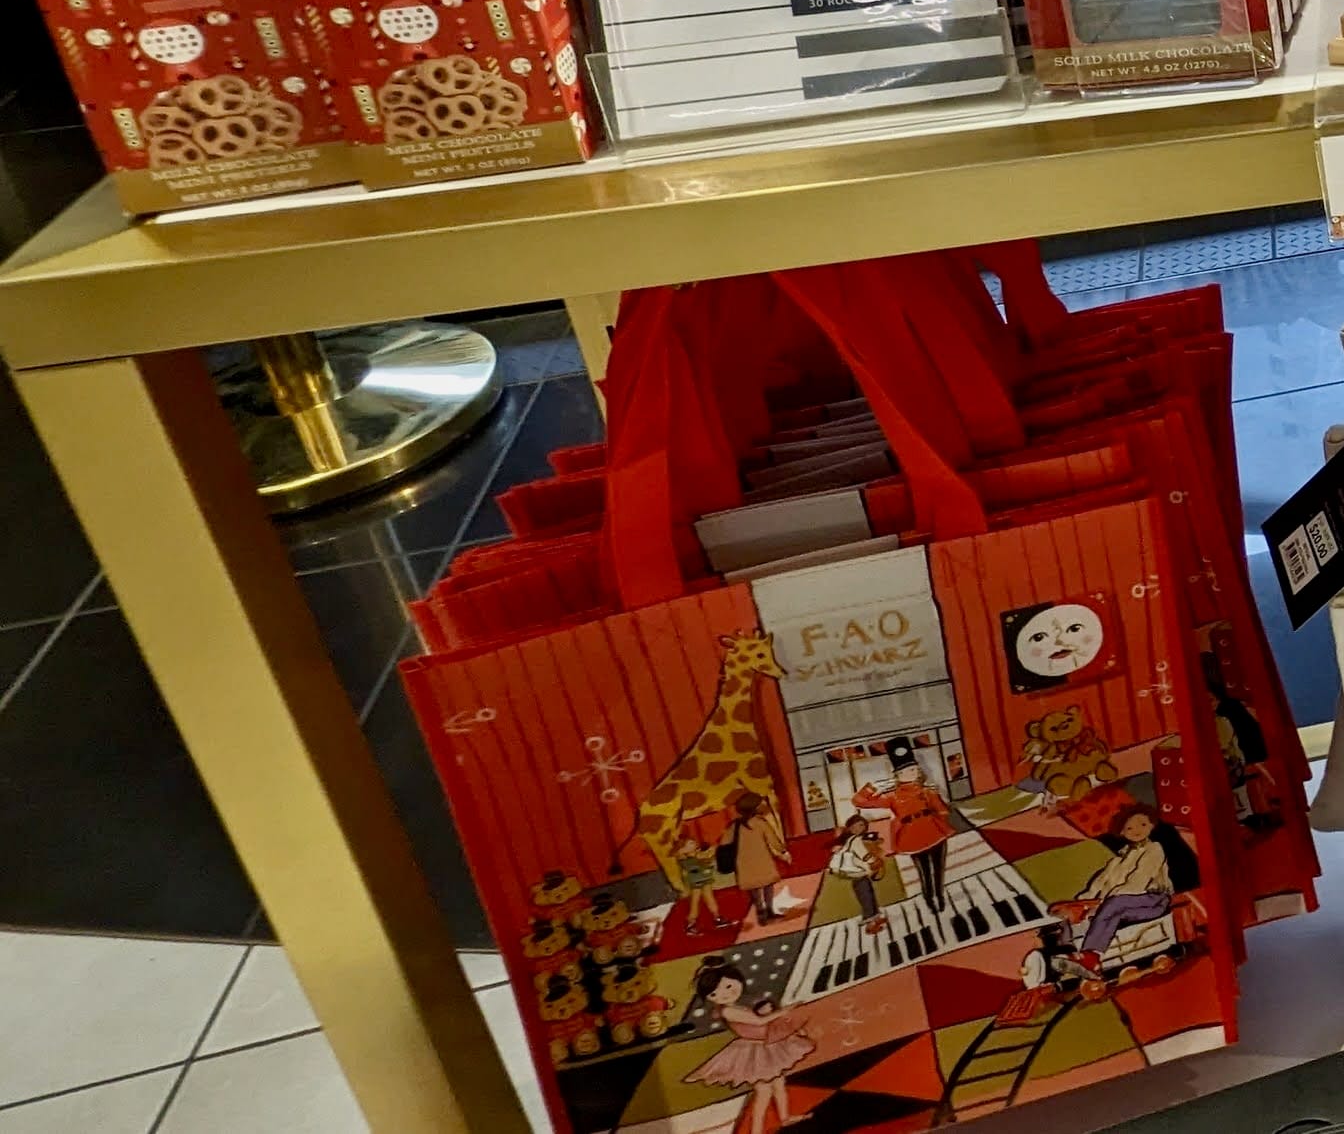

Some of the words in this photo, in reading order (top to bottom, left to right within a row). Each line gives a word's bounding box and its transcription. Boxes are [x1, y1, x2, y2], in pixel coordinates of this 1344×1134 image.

[1054, 55, 1103, 67] SOLID
[1108, 51, 1150, 64] MILK
[1155, 42, 1253, 59] CHOCOLATE
[1091, 68, 1114, 77] NET
[1117, 66, 1136, 76] WT
[1165, 63, 1180, 73] OZ
[437, 128, 543, 150] CHOCOLATE
[1308, 522, 1328, 560] $20.00
